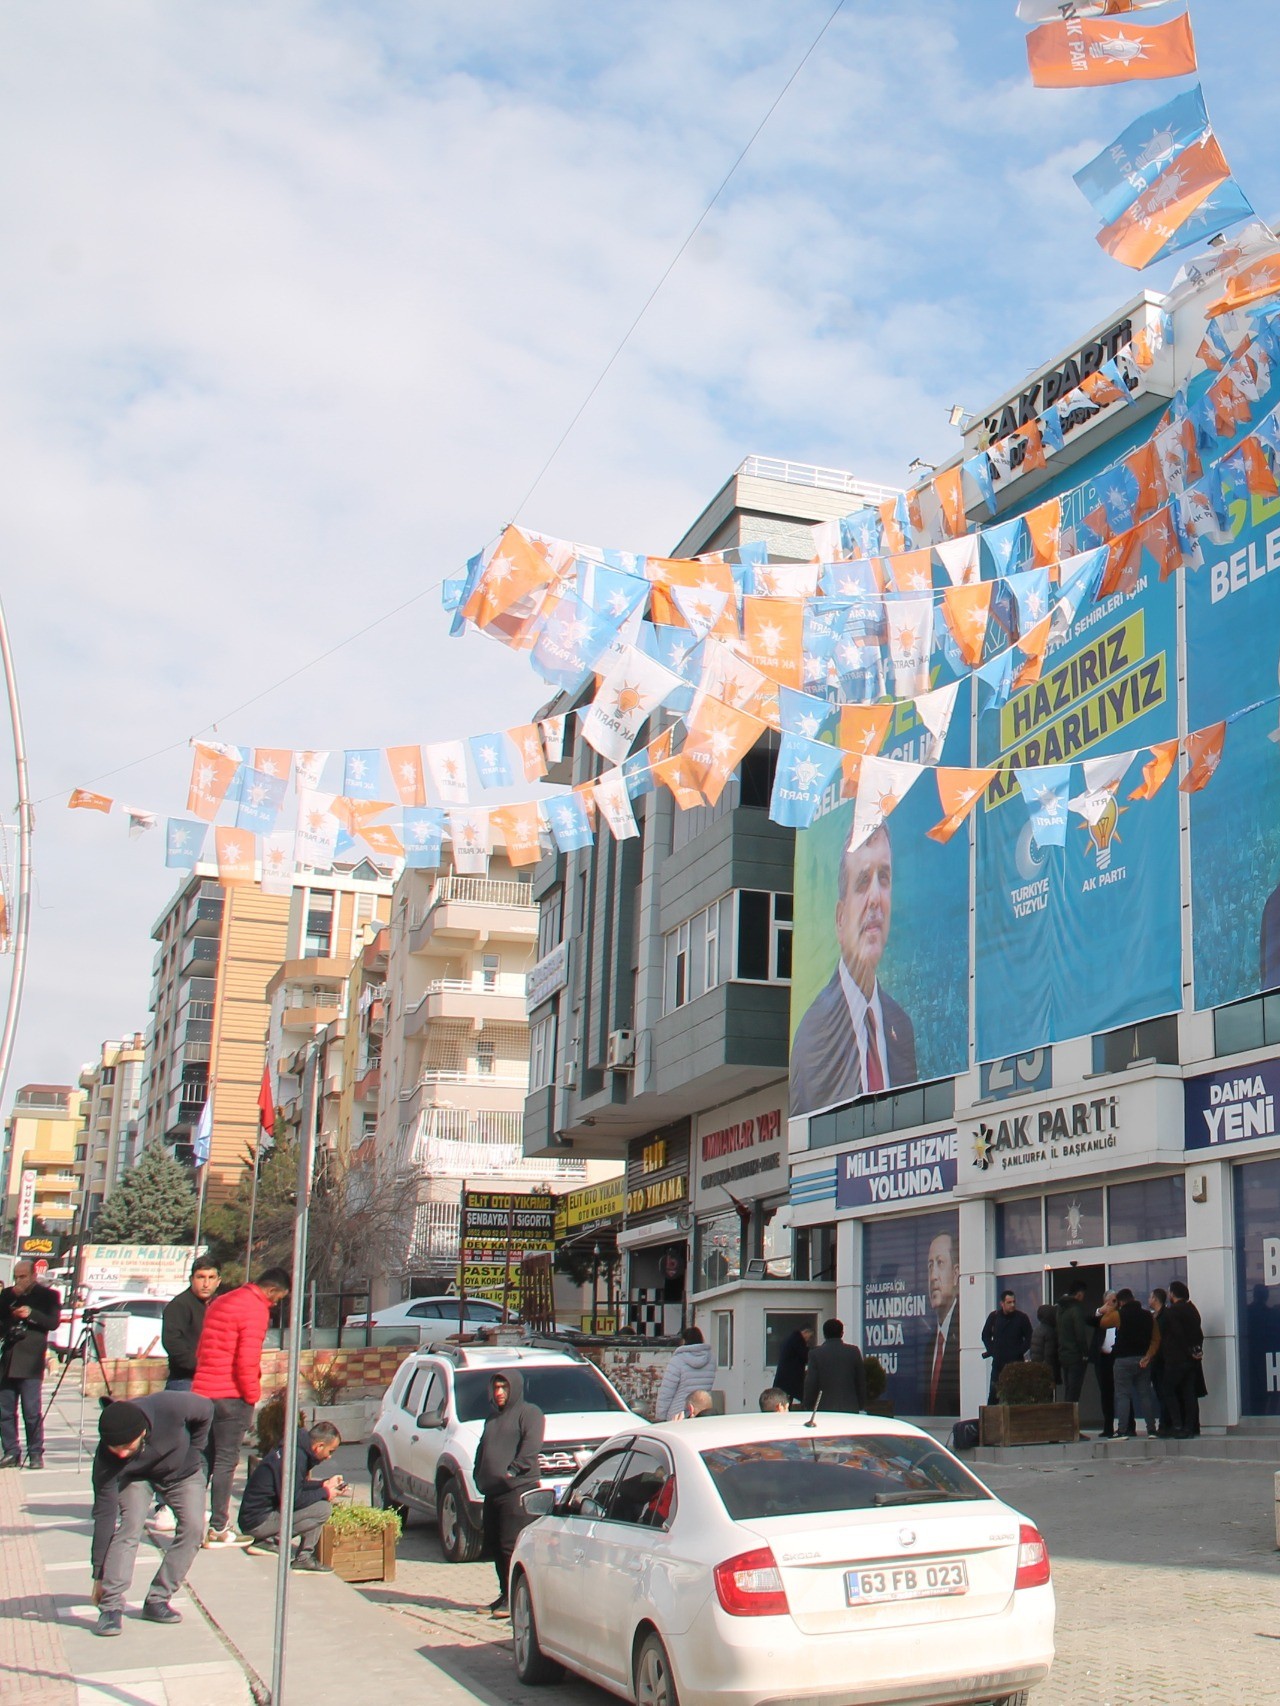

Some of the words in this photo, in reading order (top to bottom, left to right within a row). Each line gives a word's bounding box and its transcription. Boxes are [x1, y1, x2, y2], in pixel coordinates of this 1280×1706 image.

[1120, 162, 1149, 192] PAR
[997, 384, 1042, 437] AK
[1075, 592, 1123, 637] ŞEHİRLERİ
[1012, 626, 1129, 739] HAZIRIZ
[987, 658, 1163, 806] KARARLIYIZ
[1010, 877, 1050, 905] TÜRKİYE
[1082, 878, 1096, 892] AK
[1099, 866, 1126, 887] PARTİ
[1012, 893, 1049, 919] YÜZYILI
[1210, 1074, 1265, 1106] DAİMA
[756, 1109, 781, 1142] YAPI
[996, 1115, 1034, 1151] AK
[1038, 1095, 1120, 1143] PARTİ
[1203, 1096, 1274, 1144] YENİ
[643, 1136, 667, 1174] ELİT
[846, 1143, 907, 1179] MİLLETE
[910, 1133, 957, 1167] HİZME
[1002, 1151, 1047, 1170] ŞANLIURFA
[1051, 1144, 1058, 1159] İL
[1063, 1133, 1117, 1157] BAŞKANLIĞI
[570, 1193, 583, 1210] ELİT
[584, 1188, 598, 1206] OTO
[627, 1193, 645, 1215] OTO
[646, 1176, 684, 1208] YIKAMA
[869, 1168, 944, 1202] YOLUNDA
[468, 1194, 488, 1208] ELİT
[491, 1196, 511, 1208] OTO
[578, 1208, 590, 1221] OTO
[591, 1201, 616, 1218] KUAFÖR
[517, 1213, 551, 1227] SİGORTA
[94, 1247, 135, 1260] Emin
[467, 1241, 487, 1249] DEV
[491, 1242, 547, 1250] KAMPANYA
[88, 1273, 118, 1281] ATLAS
[464, 1266, 506, 1276] PASTA
[866, 1282, 893, 1296] ŞANLIURFA
[866, 1293, 926, 1319] İNANDIĞIN
[592, 1319, 615, 1332] LİT
[865, 1323, 904, 1347] YOLDA
[865, 1352, 898, 1375] RÜ
[860, 1574, 887, 1594] 63
[892, 1570, 918, 1591] FB
[926, 1565, 963, 1587] 023
